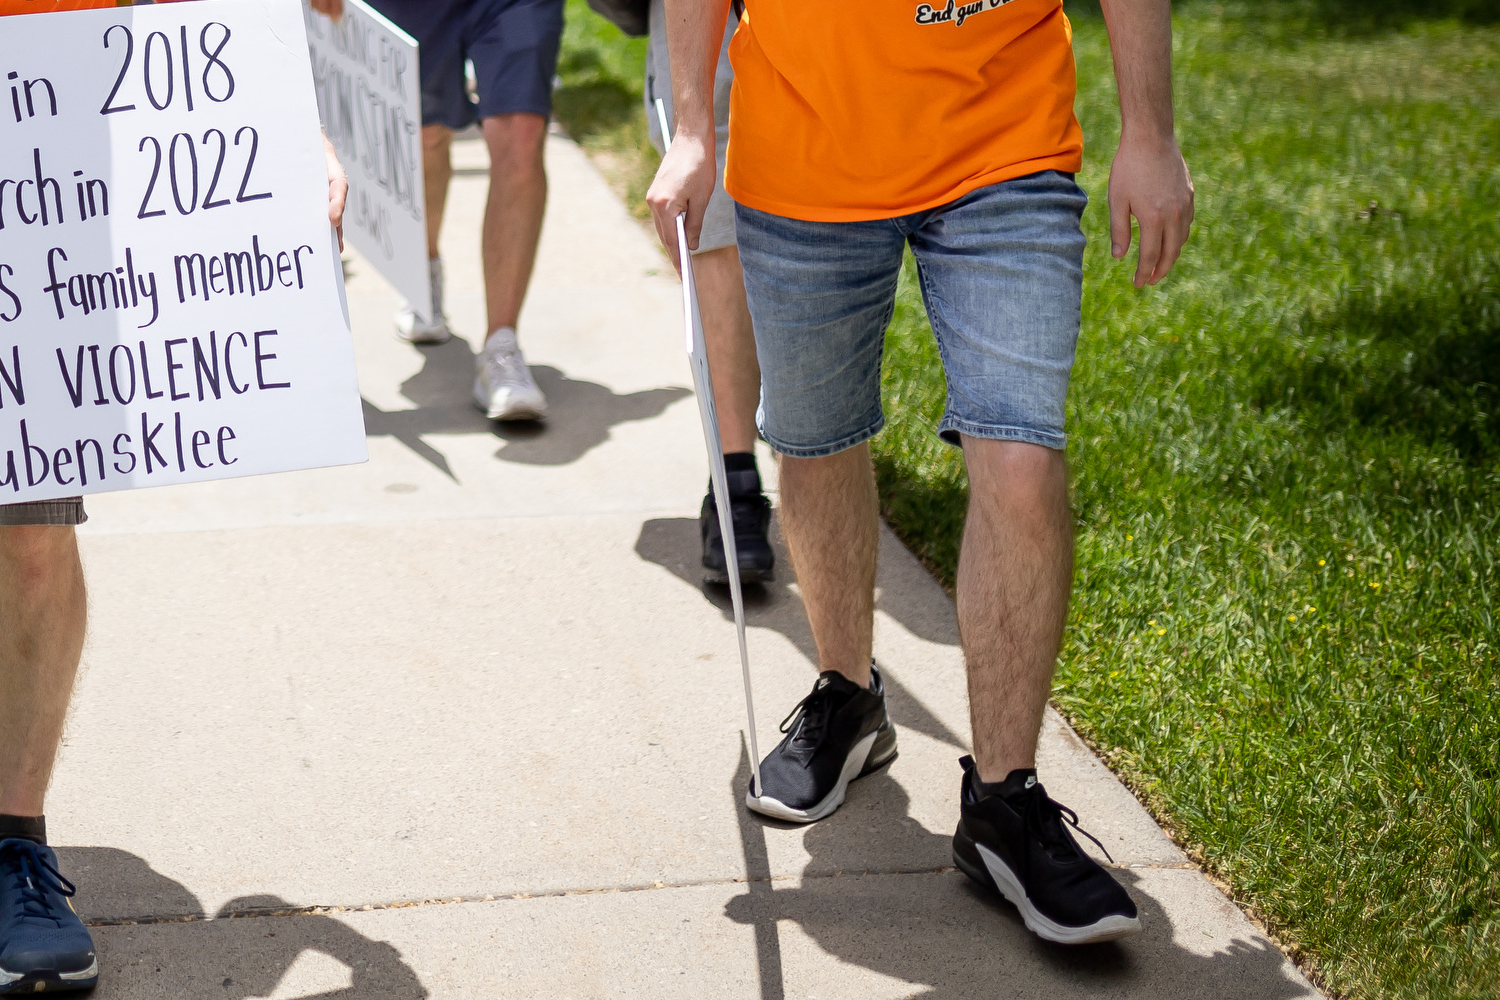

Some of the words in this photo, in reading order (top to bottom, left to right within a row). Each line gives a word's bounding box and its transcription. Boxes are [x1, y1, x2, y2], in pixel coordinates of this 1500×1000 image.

[954, 0, 984, 27] gun
[7, 70, 58, 123] in
[99, 21, 235, 116] 2018
[72, 169, 110, 222] in
[136, 126, 273, 220] 2022
[42, 246, 159, 329] family
[173, 234, 314, 310] member
[55, 329, 291, 409] VIOLENCE
